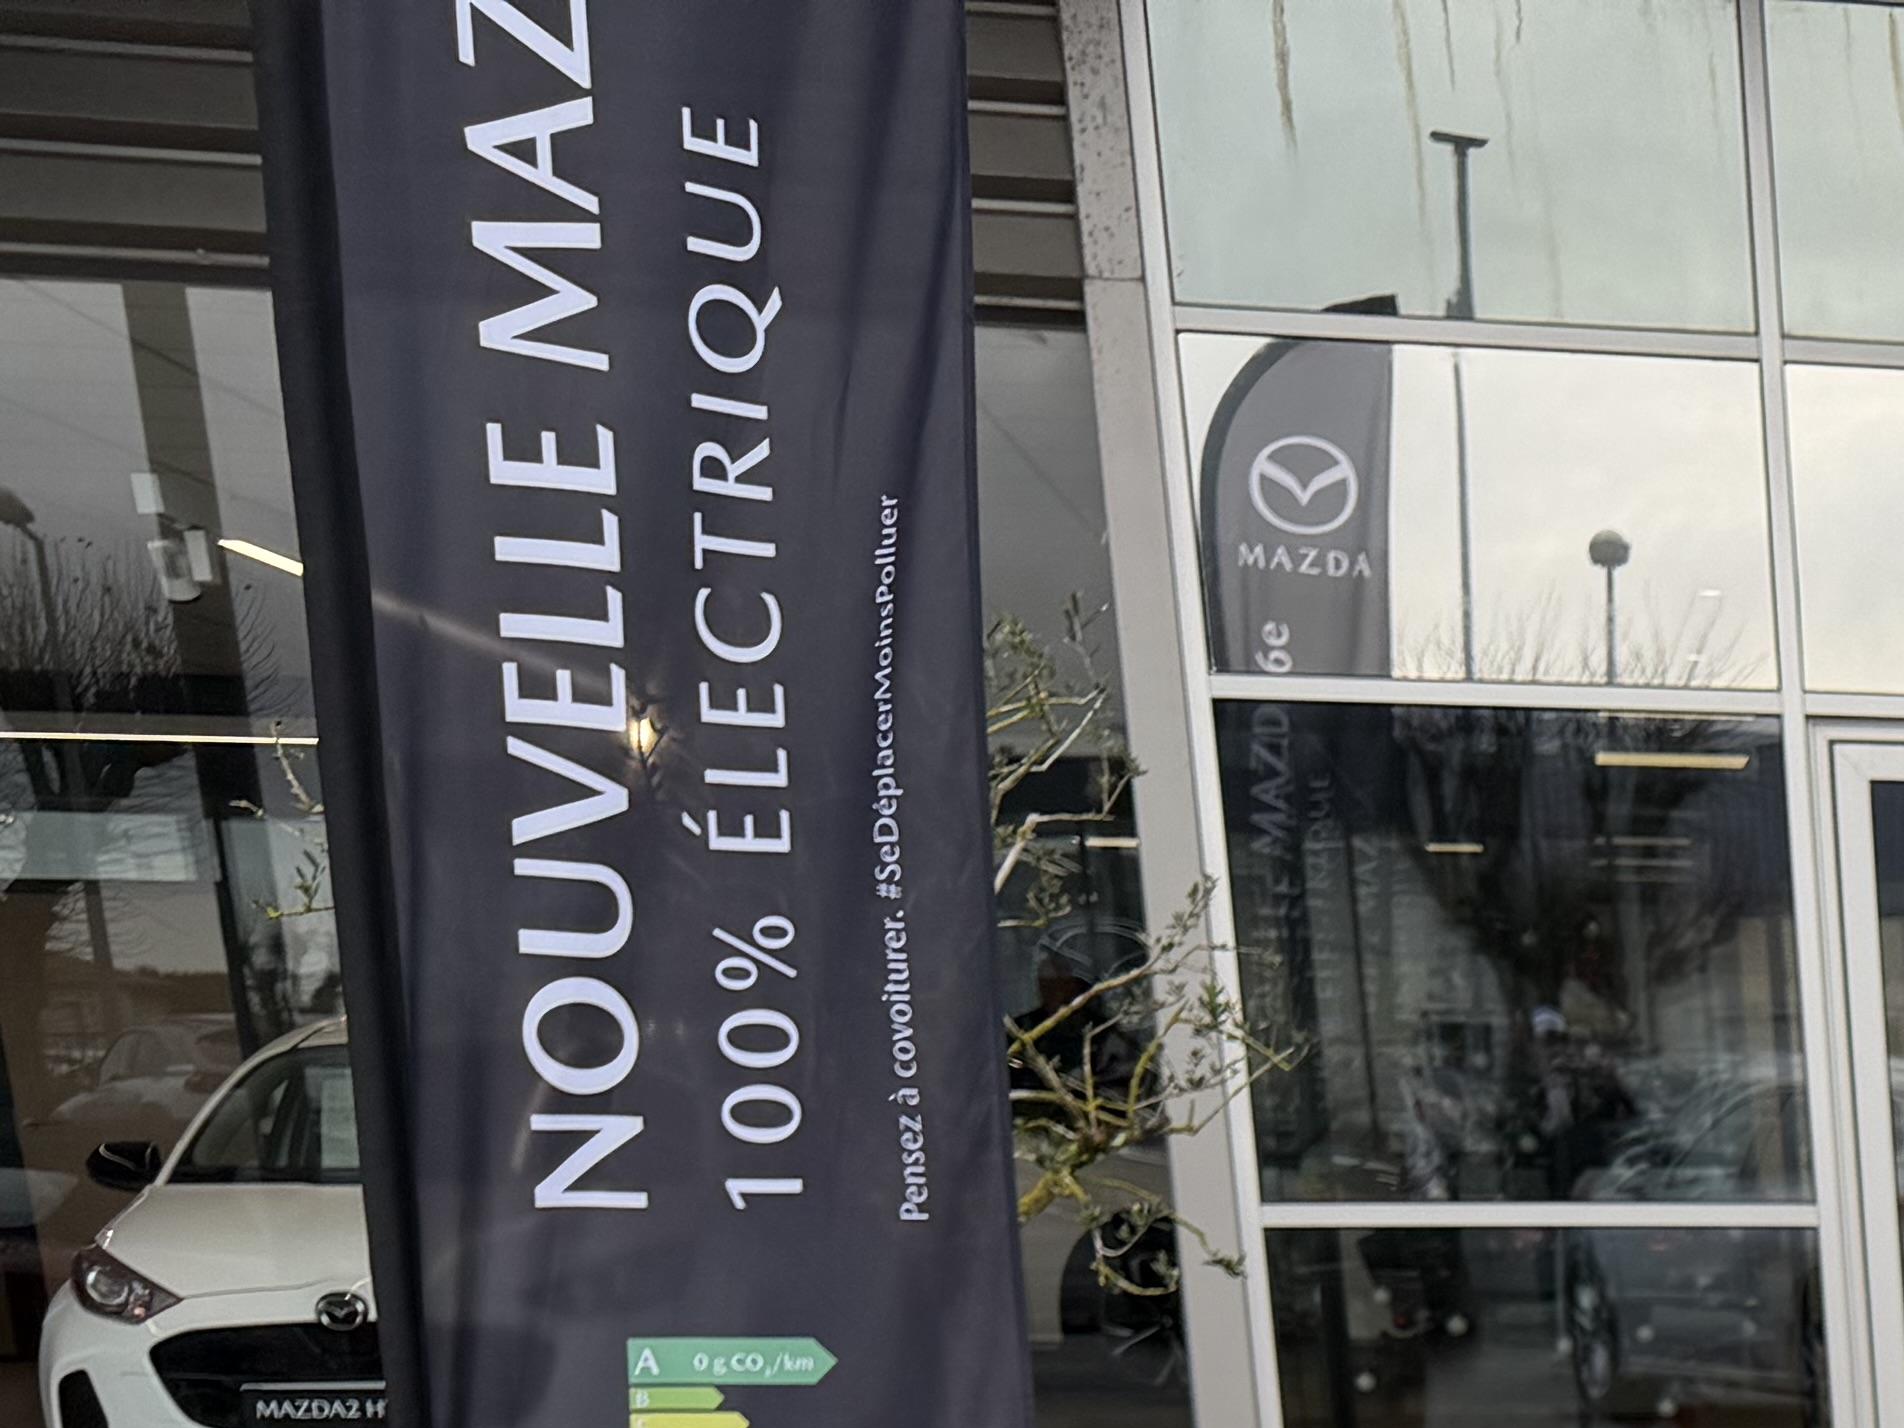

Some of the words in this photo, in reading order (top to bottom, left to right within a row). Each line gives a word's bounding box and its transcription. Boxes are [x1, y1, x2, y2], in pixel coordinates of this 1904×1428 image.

[680, 106, 792, 853] ÉLECTRIQUE
[1238, 541, 1372, 579] MAZDA
[872, 494, 904, 900] #SeDéplacerMoinsPolluer
[485, 422, 649, 1209] NOUVELLE
[1249, 704, 1294, 857] MAZD
[881, 909, 918, 1078] covoiturer.
[887, 1087, 921, 1106] à
[898, 1113, 930, 1222] Pensez
[255, 1398, 362, 1420] MAZDA2
[635, 1347, 660, 1376] A
[693, 1353, 709, 1371] 0
[713, 1356, 727, 1376] g
